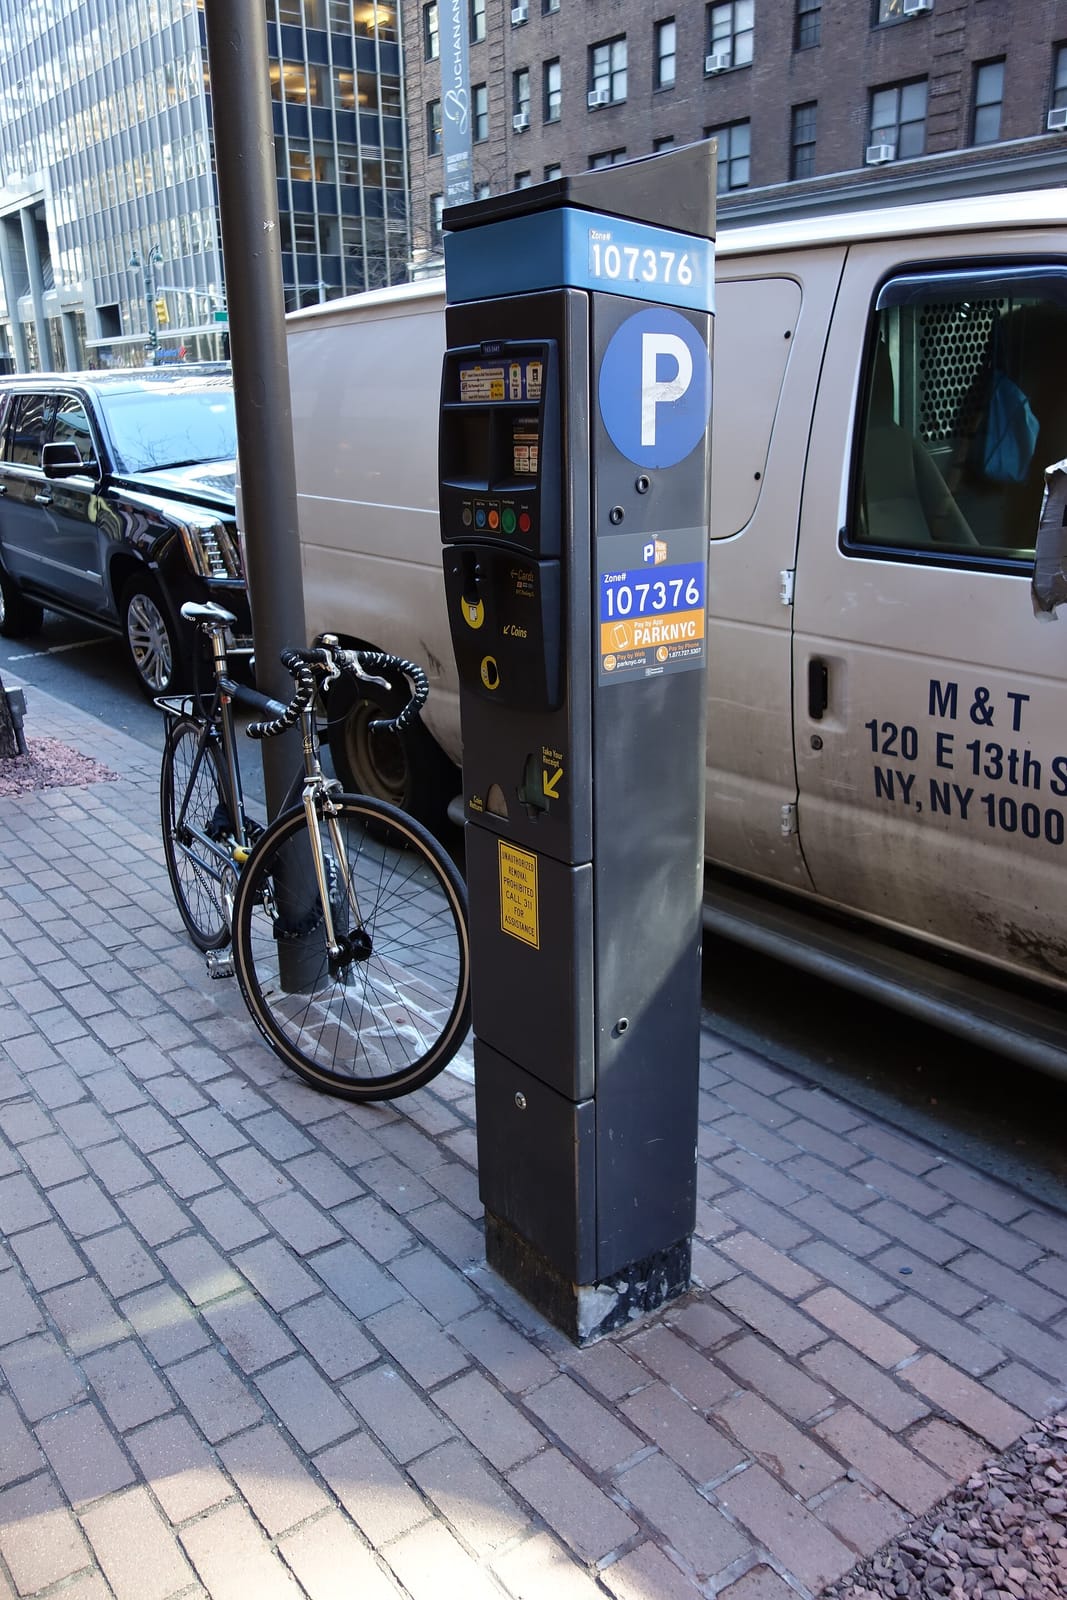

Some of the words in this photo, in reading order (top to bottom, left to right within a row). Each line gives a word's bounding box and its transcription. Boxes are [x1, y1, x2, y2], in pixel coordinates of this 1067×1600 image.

[593, 243, 692, 286] 107376
[641, 333, 693, 446] P
[604, 572, 627, 584] Zone#
[606, 577, 700, 617] 107376
[510, 625, 528, 638] Coins
[634, 620, 696, 646] PARKNYC
[928, 679, 958, 720] M
[970, 686, 994, 727] &
[1007, 691, 1030, 732] T
[865, 719, 918, 761] 120
[936, 732, 954, 770] E
[966, 739, 1041, 790] 13th
[929, 778, 974, 820] NY
[981, 793, 1064, 845] 1000
[501, 852, 534, 872] UNAUTHORIZED
[508, 866, 528, 882] REMOVAL
[503, 876, 534, 898] PROHIBITED
[505, 890, 521, 906] CALL
[523, 898, 533, 911] 311
[514, 906, 525, 918] FOR
[504, 914, 535, 937] ASSISTANCE
